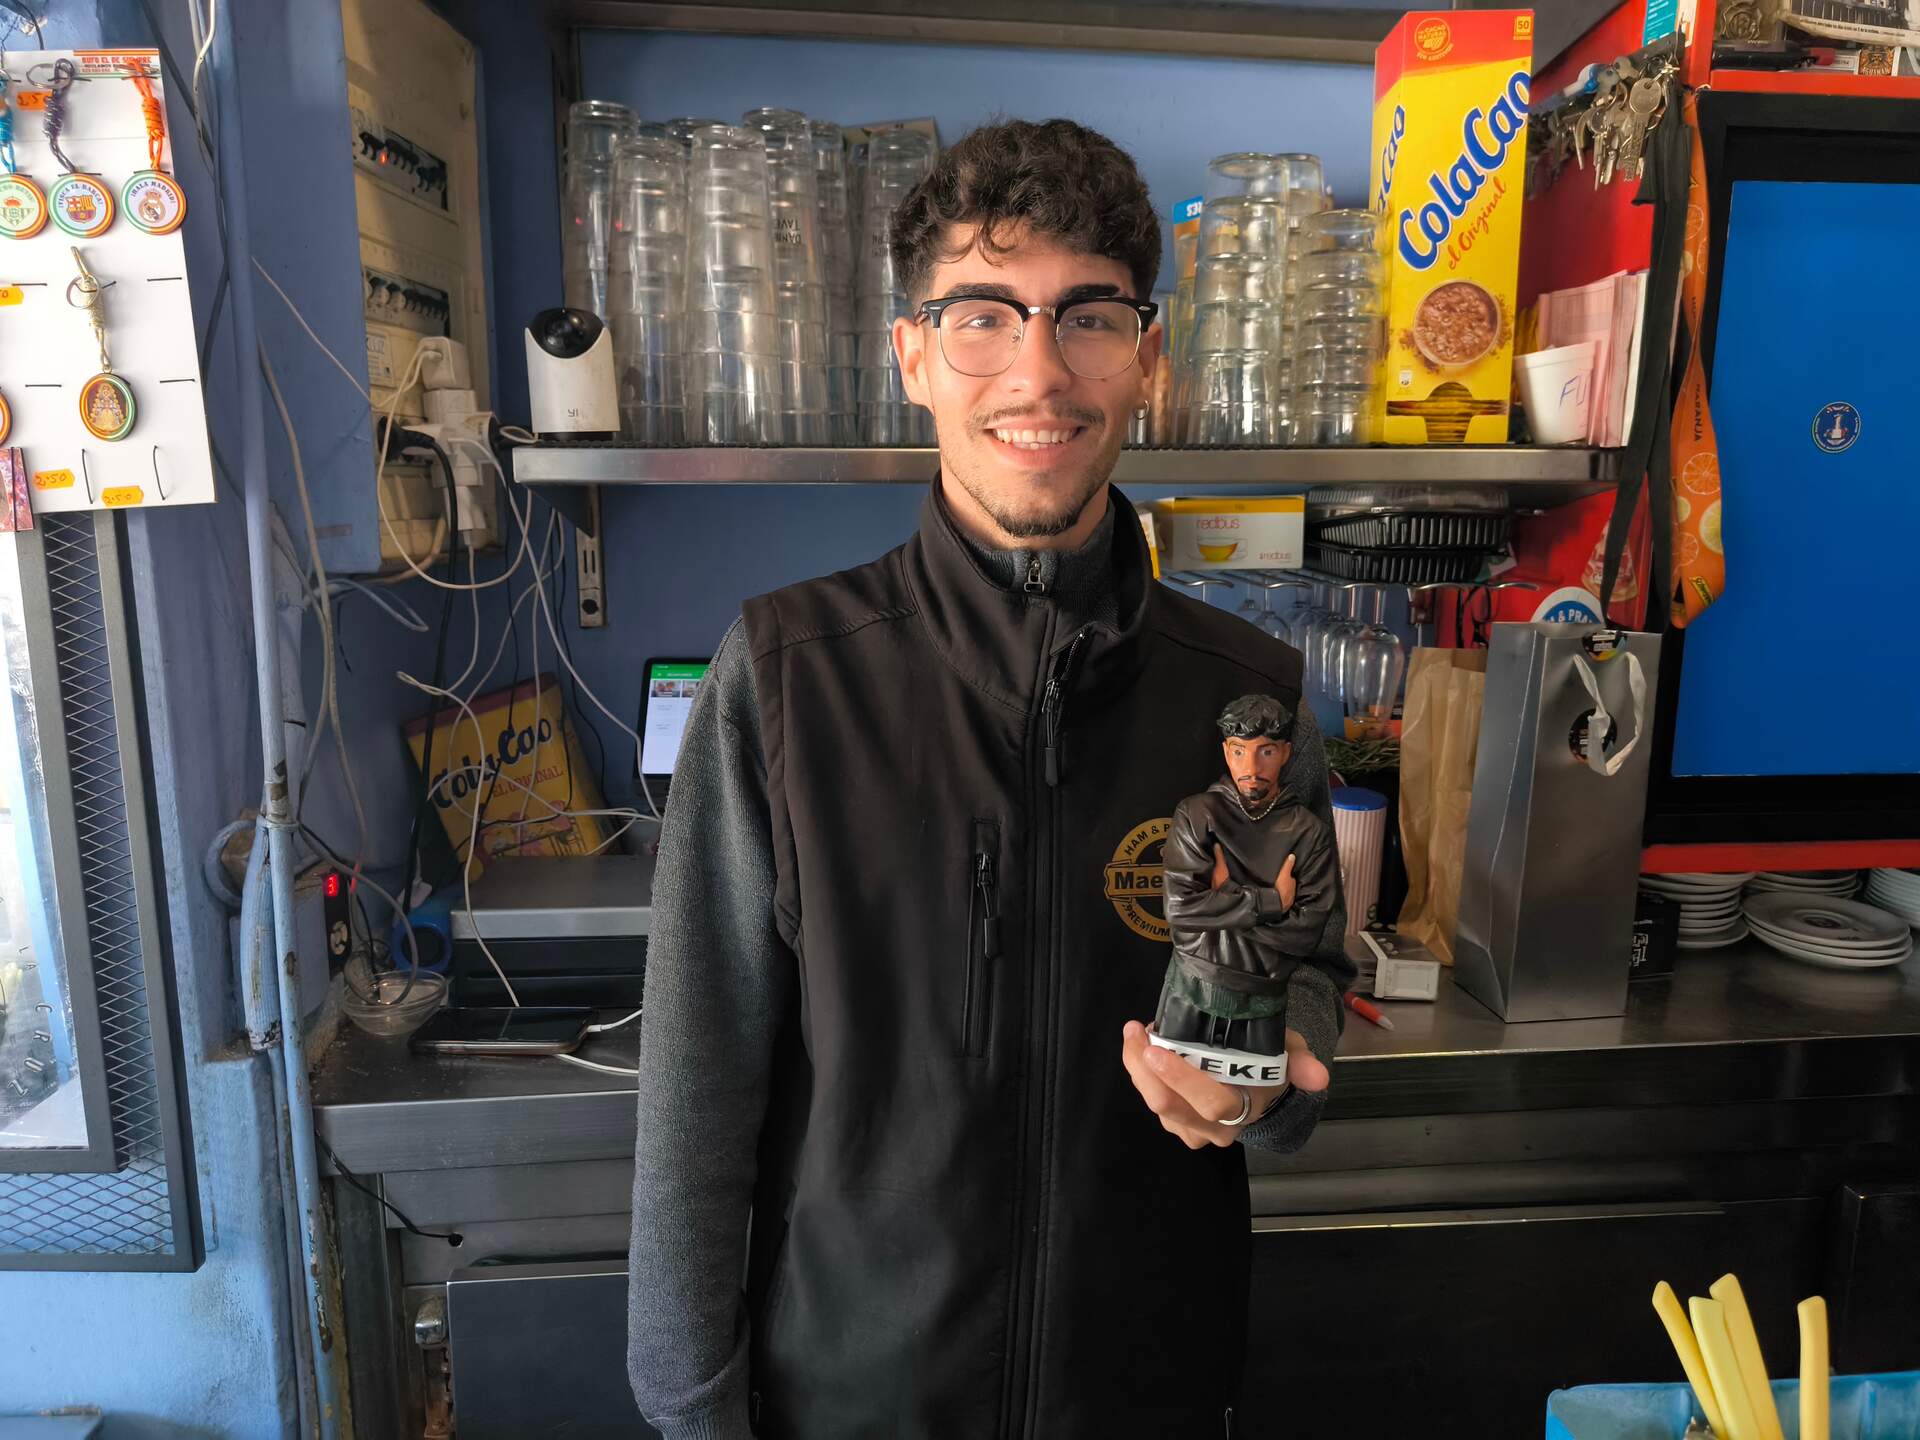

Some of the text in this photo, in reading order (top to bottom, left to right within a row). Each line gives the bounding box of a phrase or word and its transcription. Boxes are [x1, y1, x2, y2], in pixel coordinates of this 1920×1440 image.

[1517, 20, 1530, 30] 50
[1398, 71, 1531, 269] ColaCao
[1459, 176, 1507, 252] Original
[1568, 608, 1593, 624] PRA
[1124, 830, 1149, 857] HAM
[1151, 825, 1160, 835] &
[1124, 904, 1171, 938] PREMIUM
[1178, 1052, 1281, 1081] EKE
